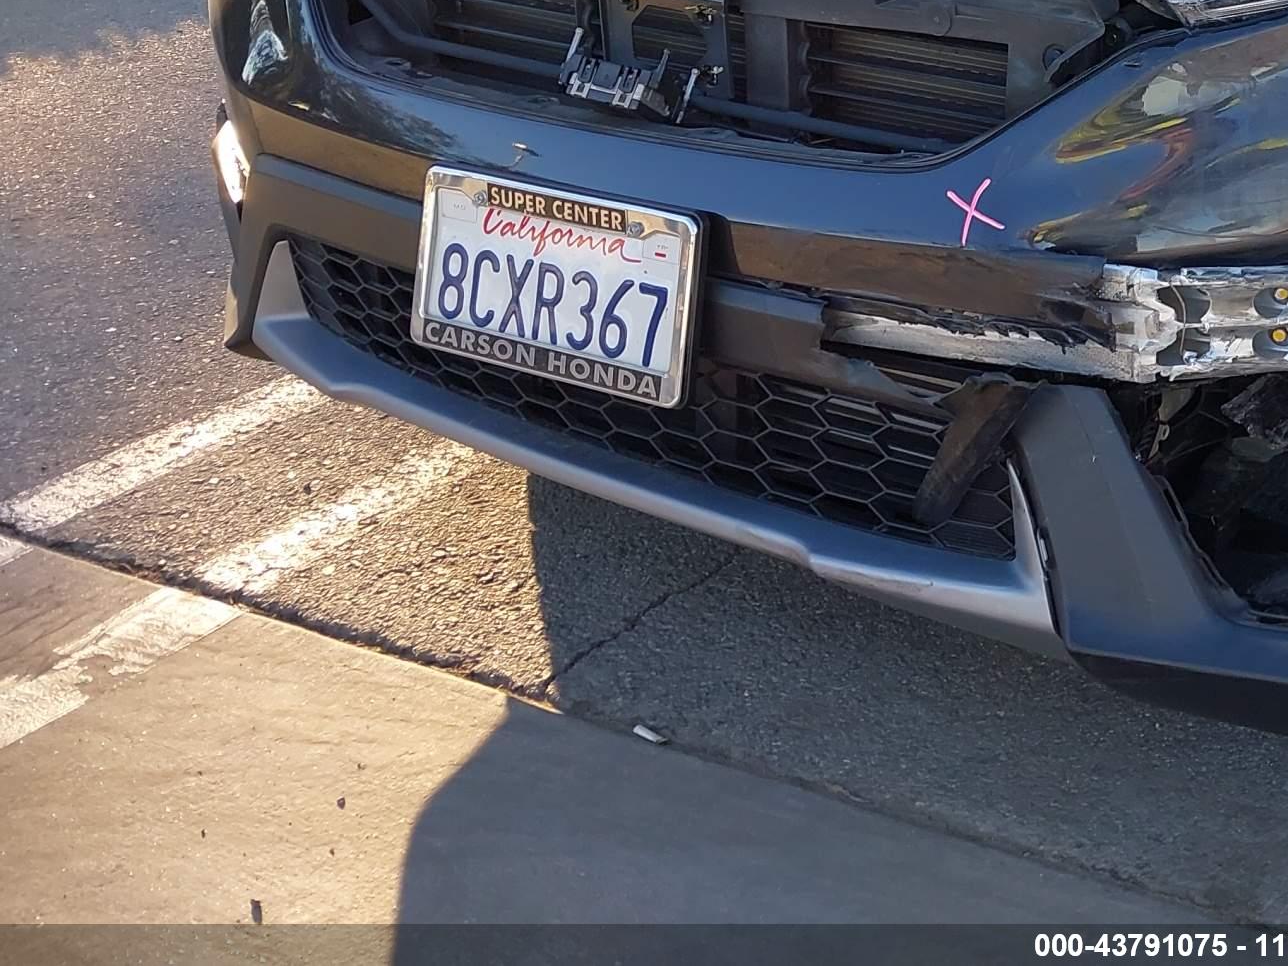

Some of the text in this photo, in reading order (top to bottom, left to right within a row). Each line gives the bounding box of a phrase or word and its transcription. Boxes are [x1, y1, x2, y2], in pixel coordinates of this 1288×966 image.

[482, 206, 641, 263] California
[490, 186, 623, 231] SUPER CENTER
[438, 243, 668, 367] 8CXR367
[425, 321, 657, 398] CARSON HONDA
